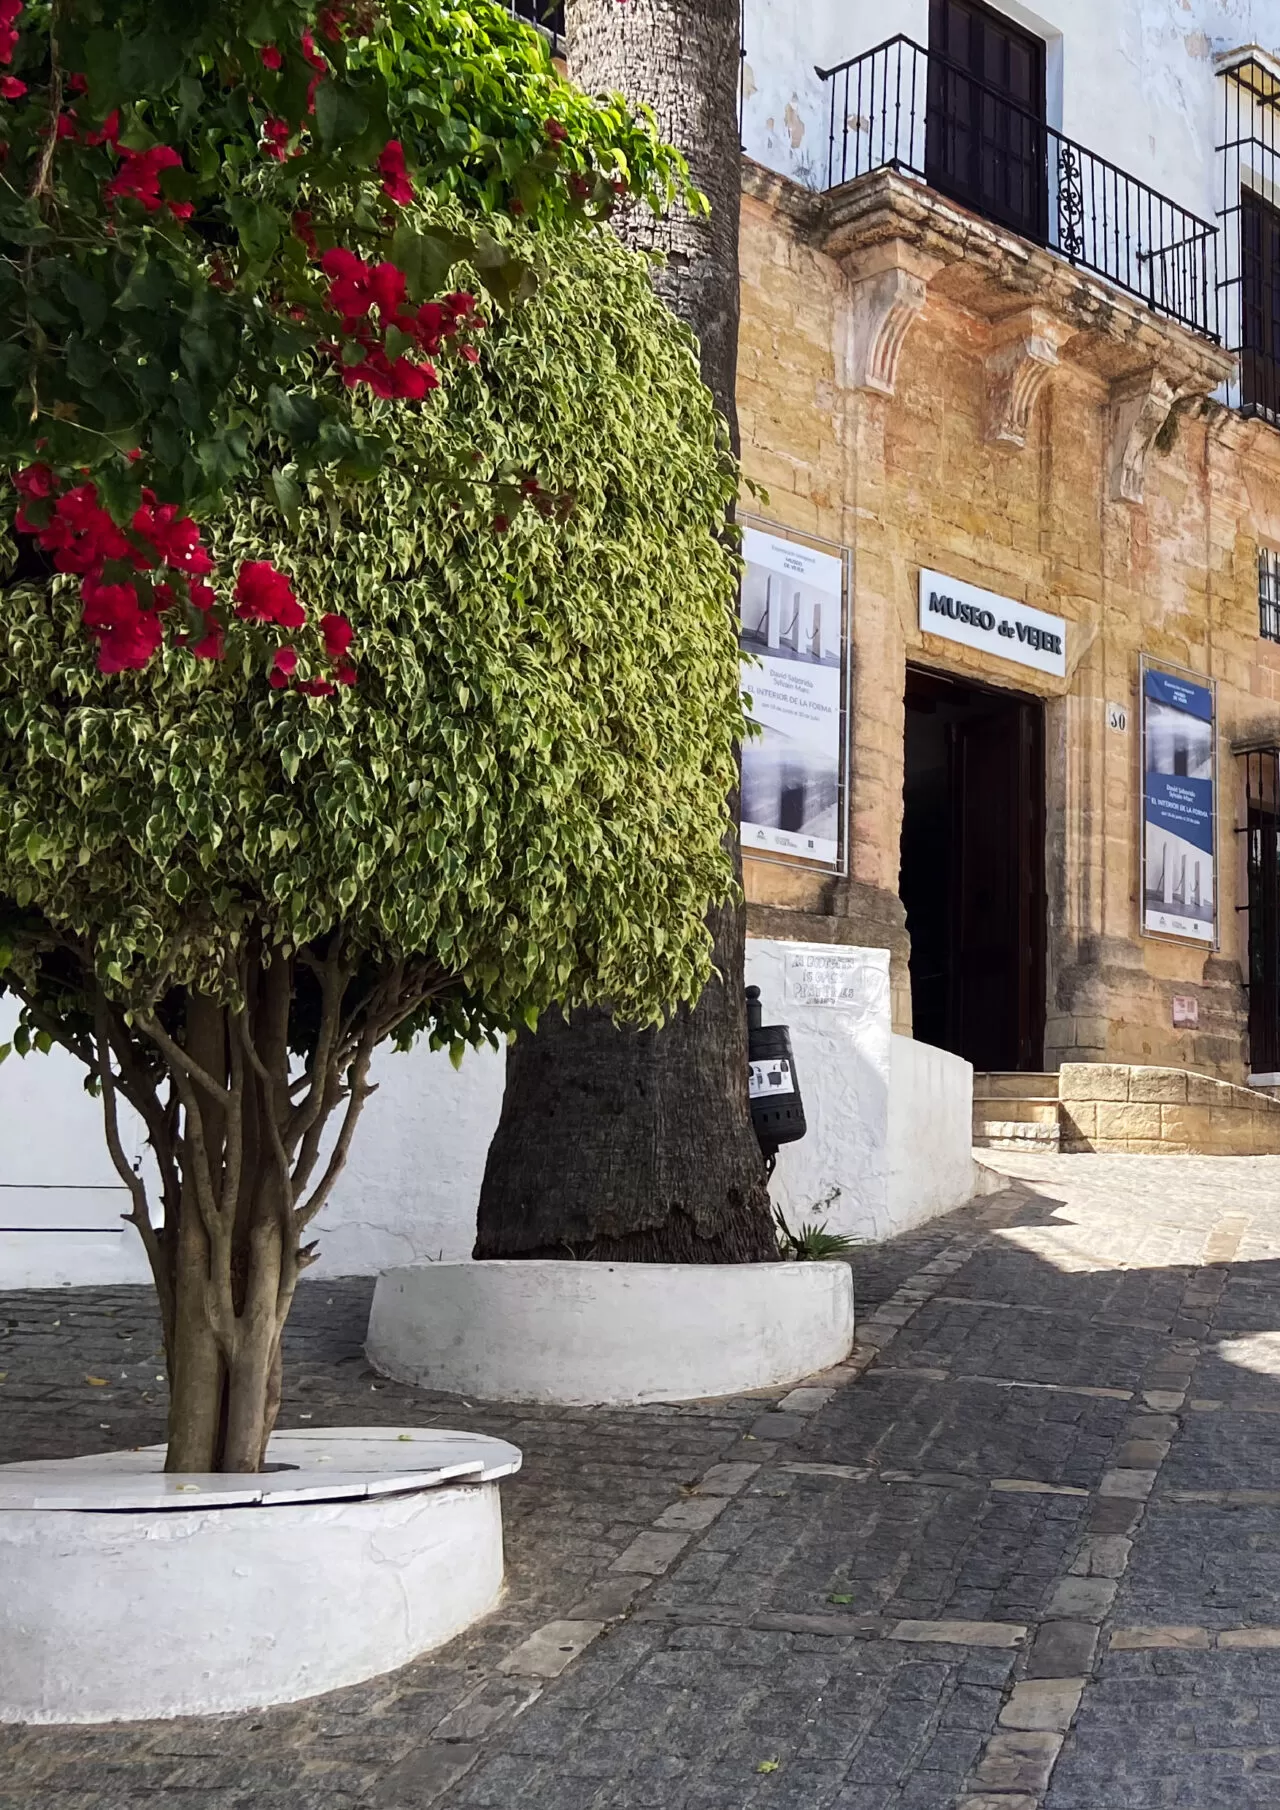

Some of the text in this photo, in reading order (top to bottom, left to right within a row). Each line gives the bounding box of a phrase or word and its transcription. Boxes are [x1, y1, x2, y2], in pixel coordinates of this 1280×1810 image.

[929, 592, 1062, 655] MUSEO de VEJER
[770, 669, 787, 679] David
[748, 685, 832, 713] EL INTERIOR DE LA FORMA
